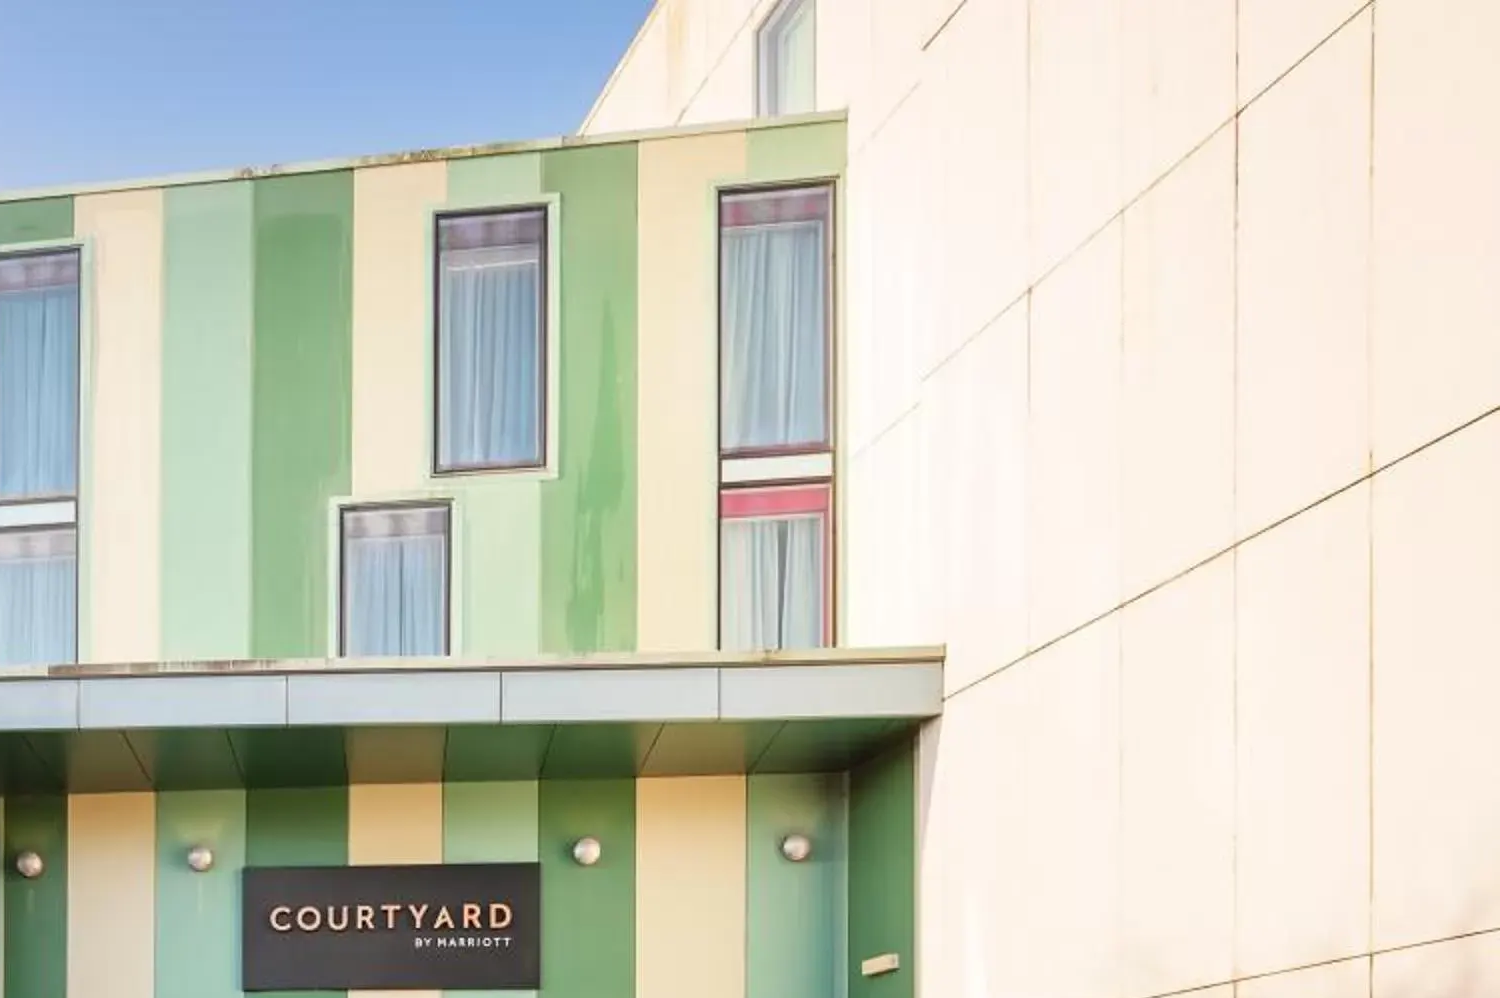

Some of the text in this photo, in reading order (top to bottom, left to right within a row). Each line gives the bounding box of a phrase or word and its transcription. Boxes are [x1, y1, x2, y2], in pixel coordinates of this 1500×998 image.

[269, 902, 514, 931] COURTYARD
[414, 937, 512, 948] BY MARRIOTT
